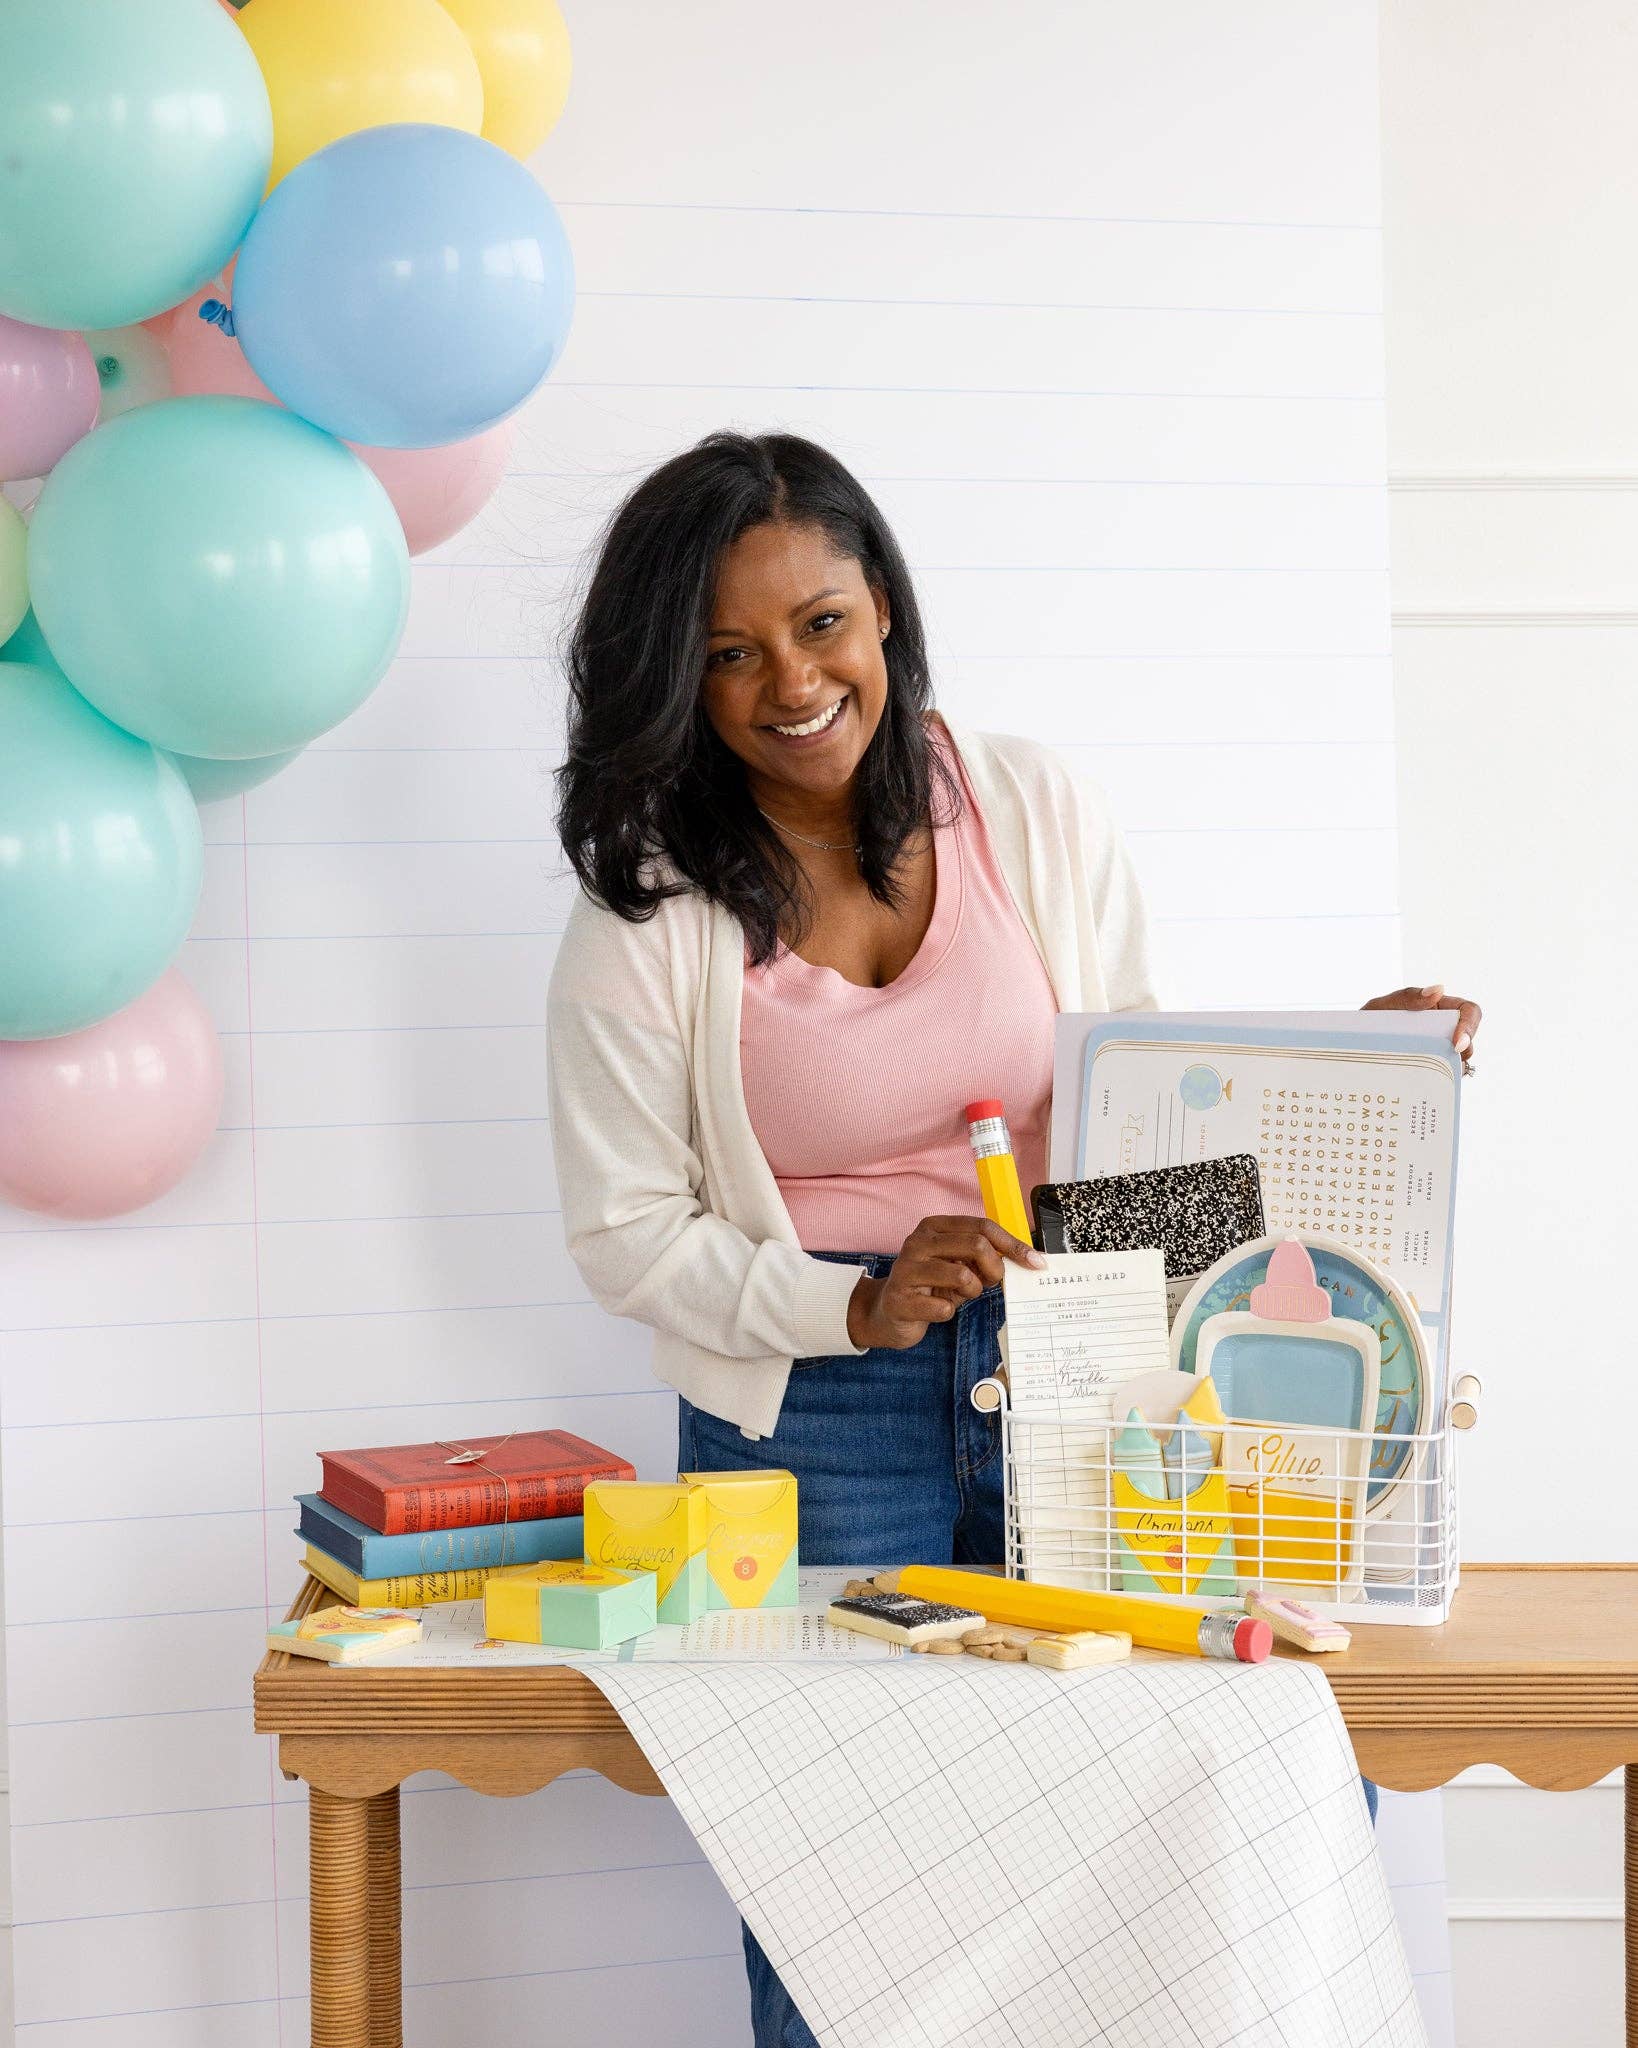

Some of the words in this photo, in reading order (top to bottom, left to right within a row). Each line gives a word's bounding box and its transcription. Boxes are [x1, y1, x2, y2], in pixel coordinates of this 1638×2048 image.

[1406, 1163, 1414, 1206] NOTEBOOK
[1038, 1274, 1091, 1286] LIBRARY
[1096, 1272, 1127, 1281] CARD
[1319, 1276, 1355, 1298] CAN
[1246, 1434, 1325, 1498] Glue
[440, 1491, 448, 1526] WOMAN
[599, 1531, 676, 1570] Crayons
[741, 1563, 751, 1575] 8
